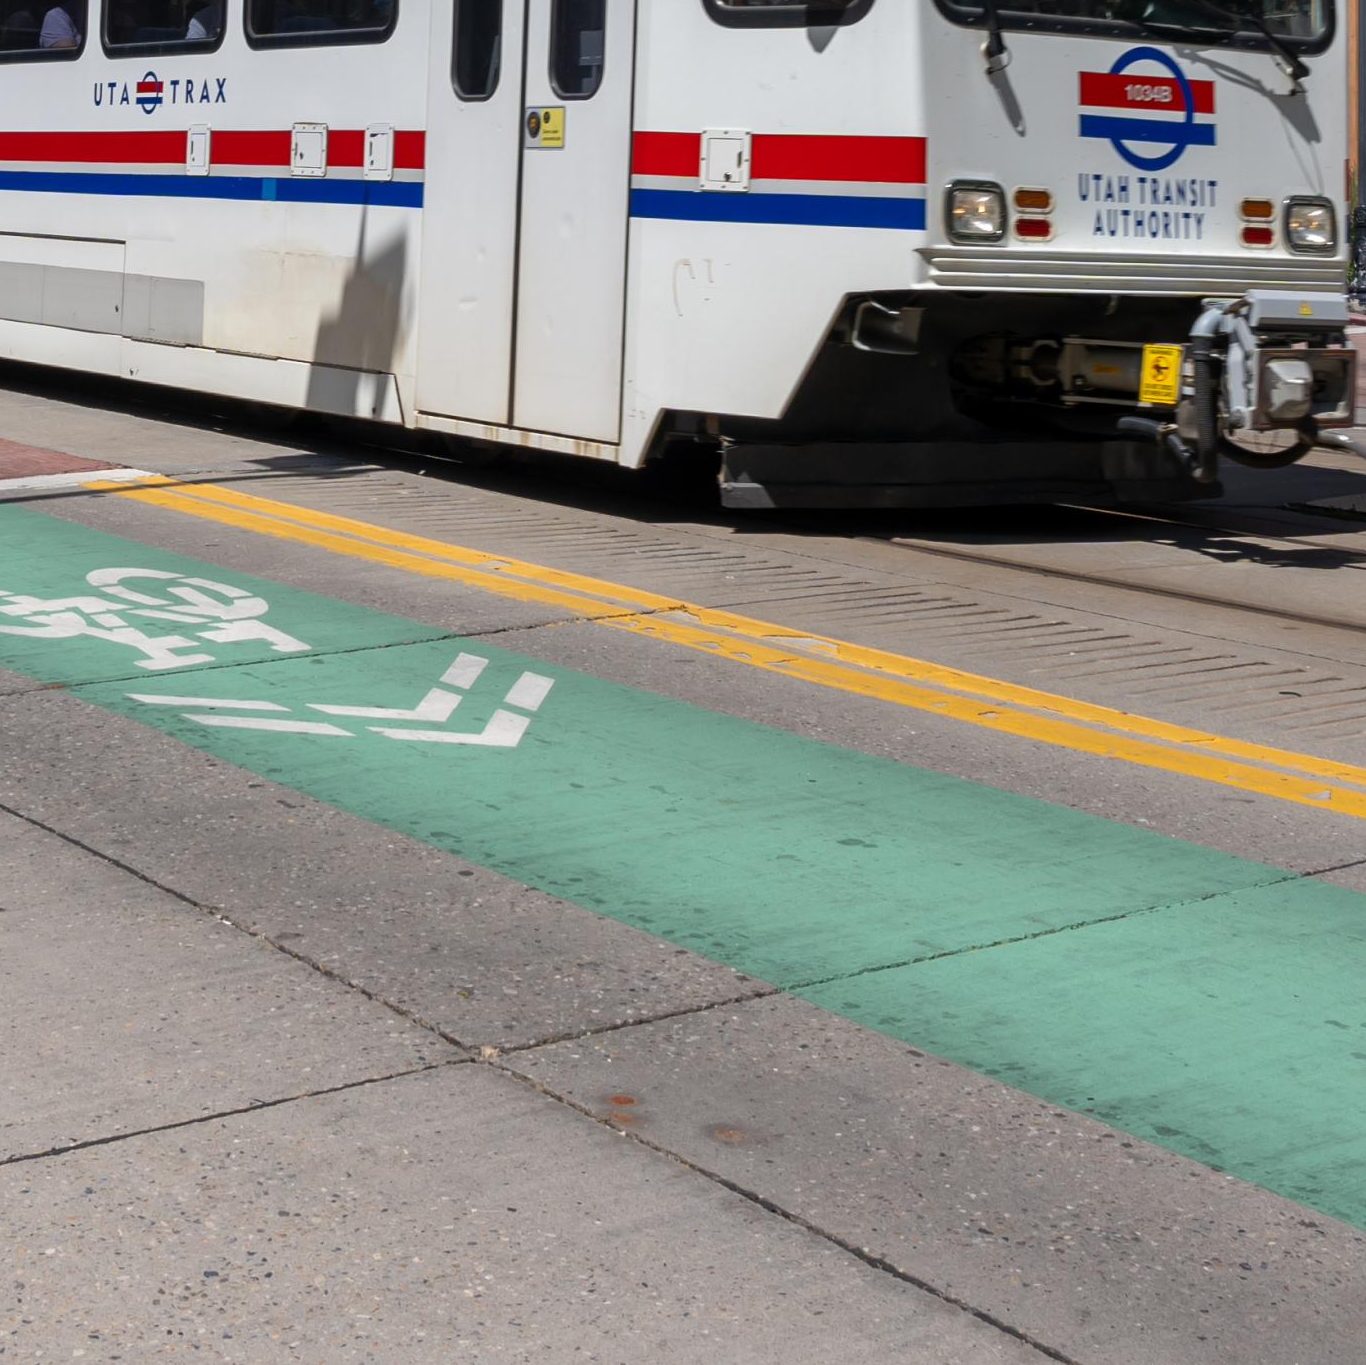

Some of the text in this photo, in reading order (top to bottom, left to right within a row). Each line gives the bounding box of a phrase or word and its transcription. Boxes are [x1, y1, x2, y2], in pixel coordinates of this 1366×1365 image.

[94, 78, 227, 107] UTA TRAX
[1124, 83, 1173, 103] 1034B
[1078, 173, 1218, 207] UTAH TRANSIT
[1093, 209, 1205, 240] AUTHORITY
